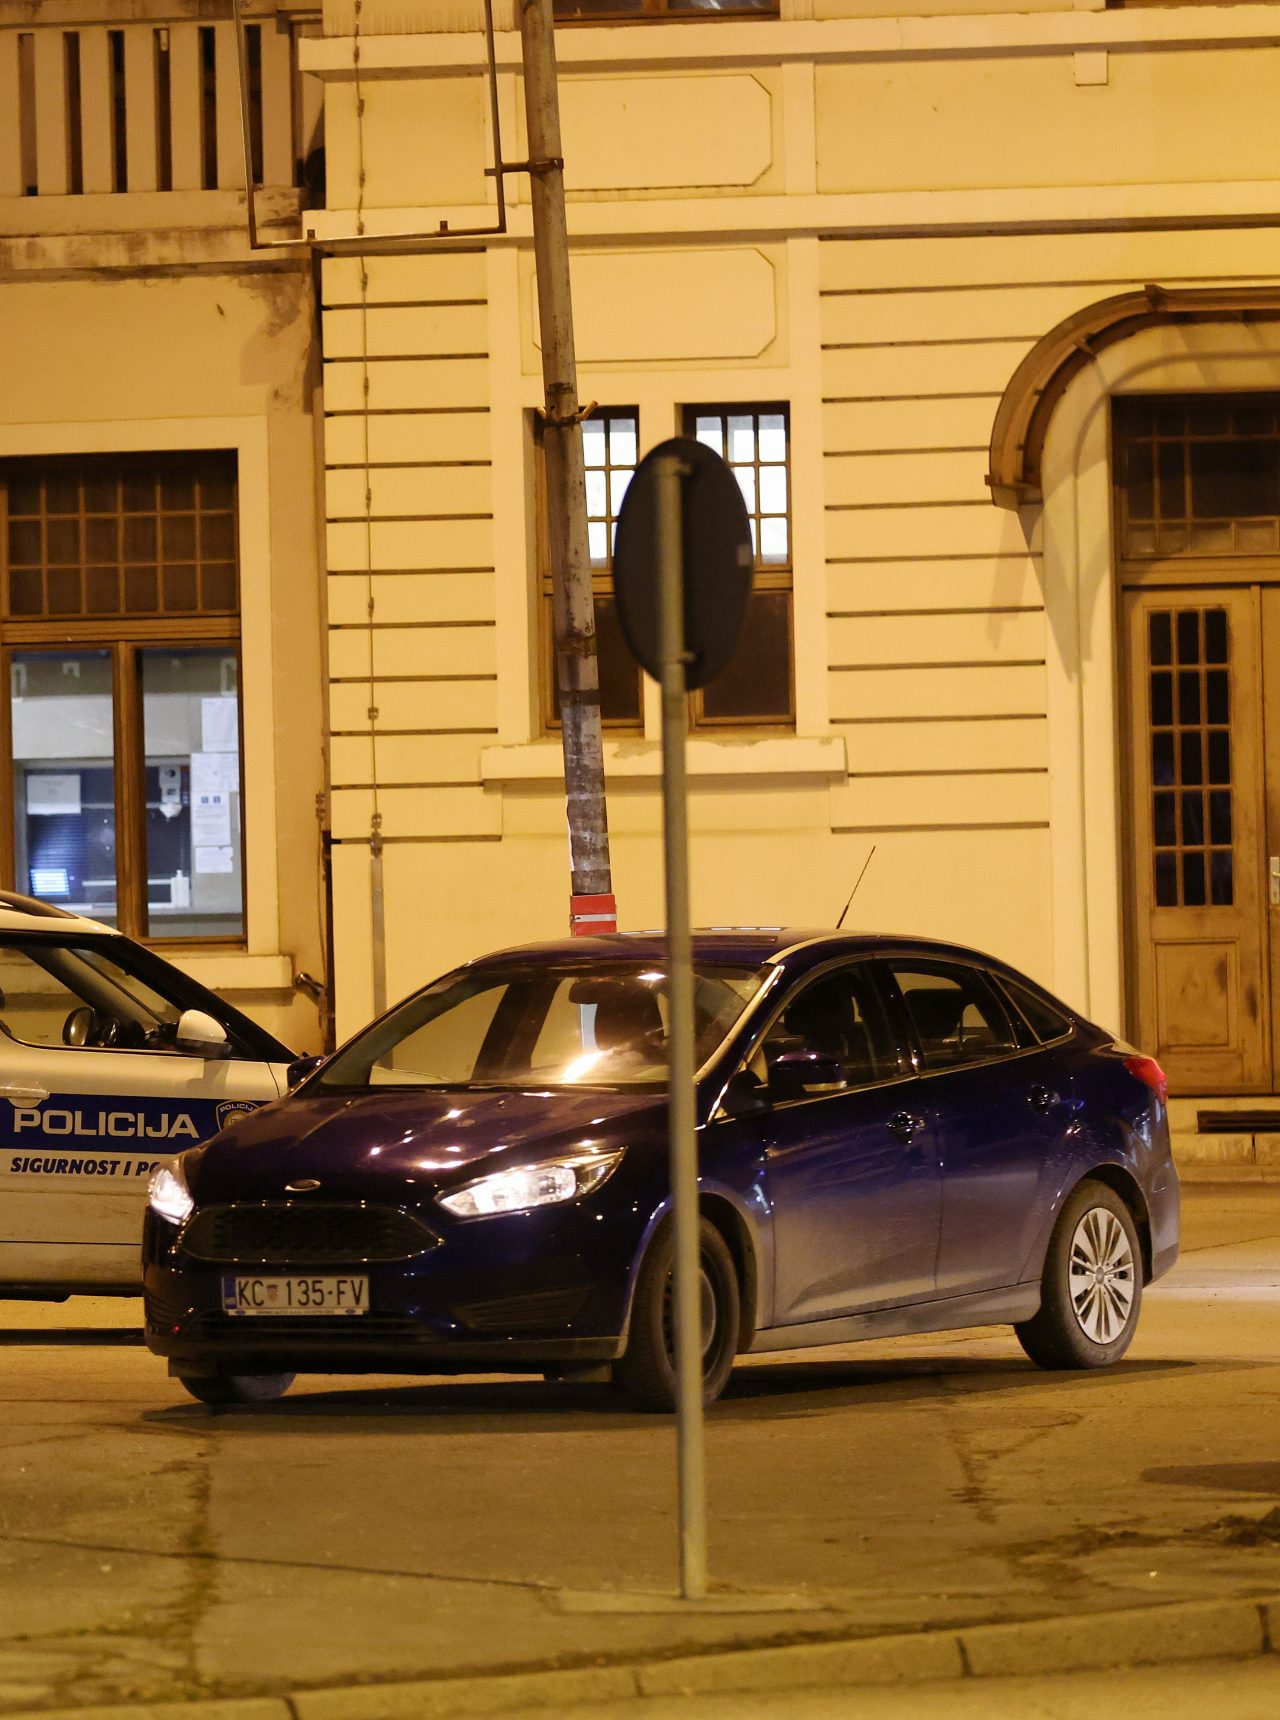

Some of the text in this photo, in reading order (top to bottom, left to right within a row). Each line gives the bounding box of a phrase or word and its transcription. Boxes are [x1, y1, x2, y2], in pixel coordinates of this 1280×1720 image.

[220, 1103, 255, 1113] POLICIJ
[13, 1108, 200, 1139] POLICIJA
[10, 1157, 121, 1176] SIGURNOST
[123, 1161, 132, 1176] I
[238, 1280, 363, 1306] KC 135-FV
